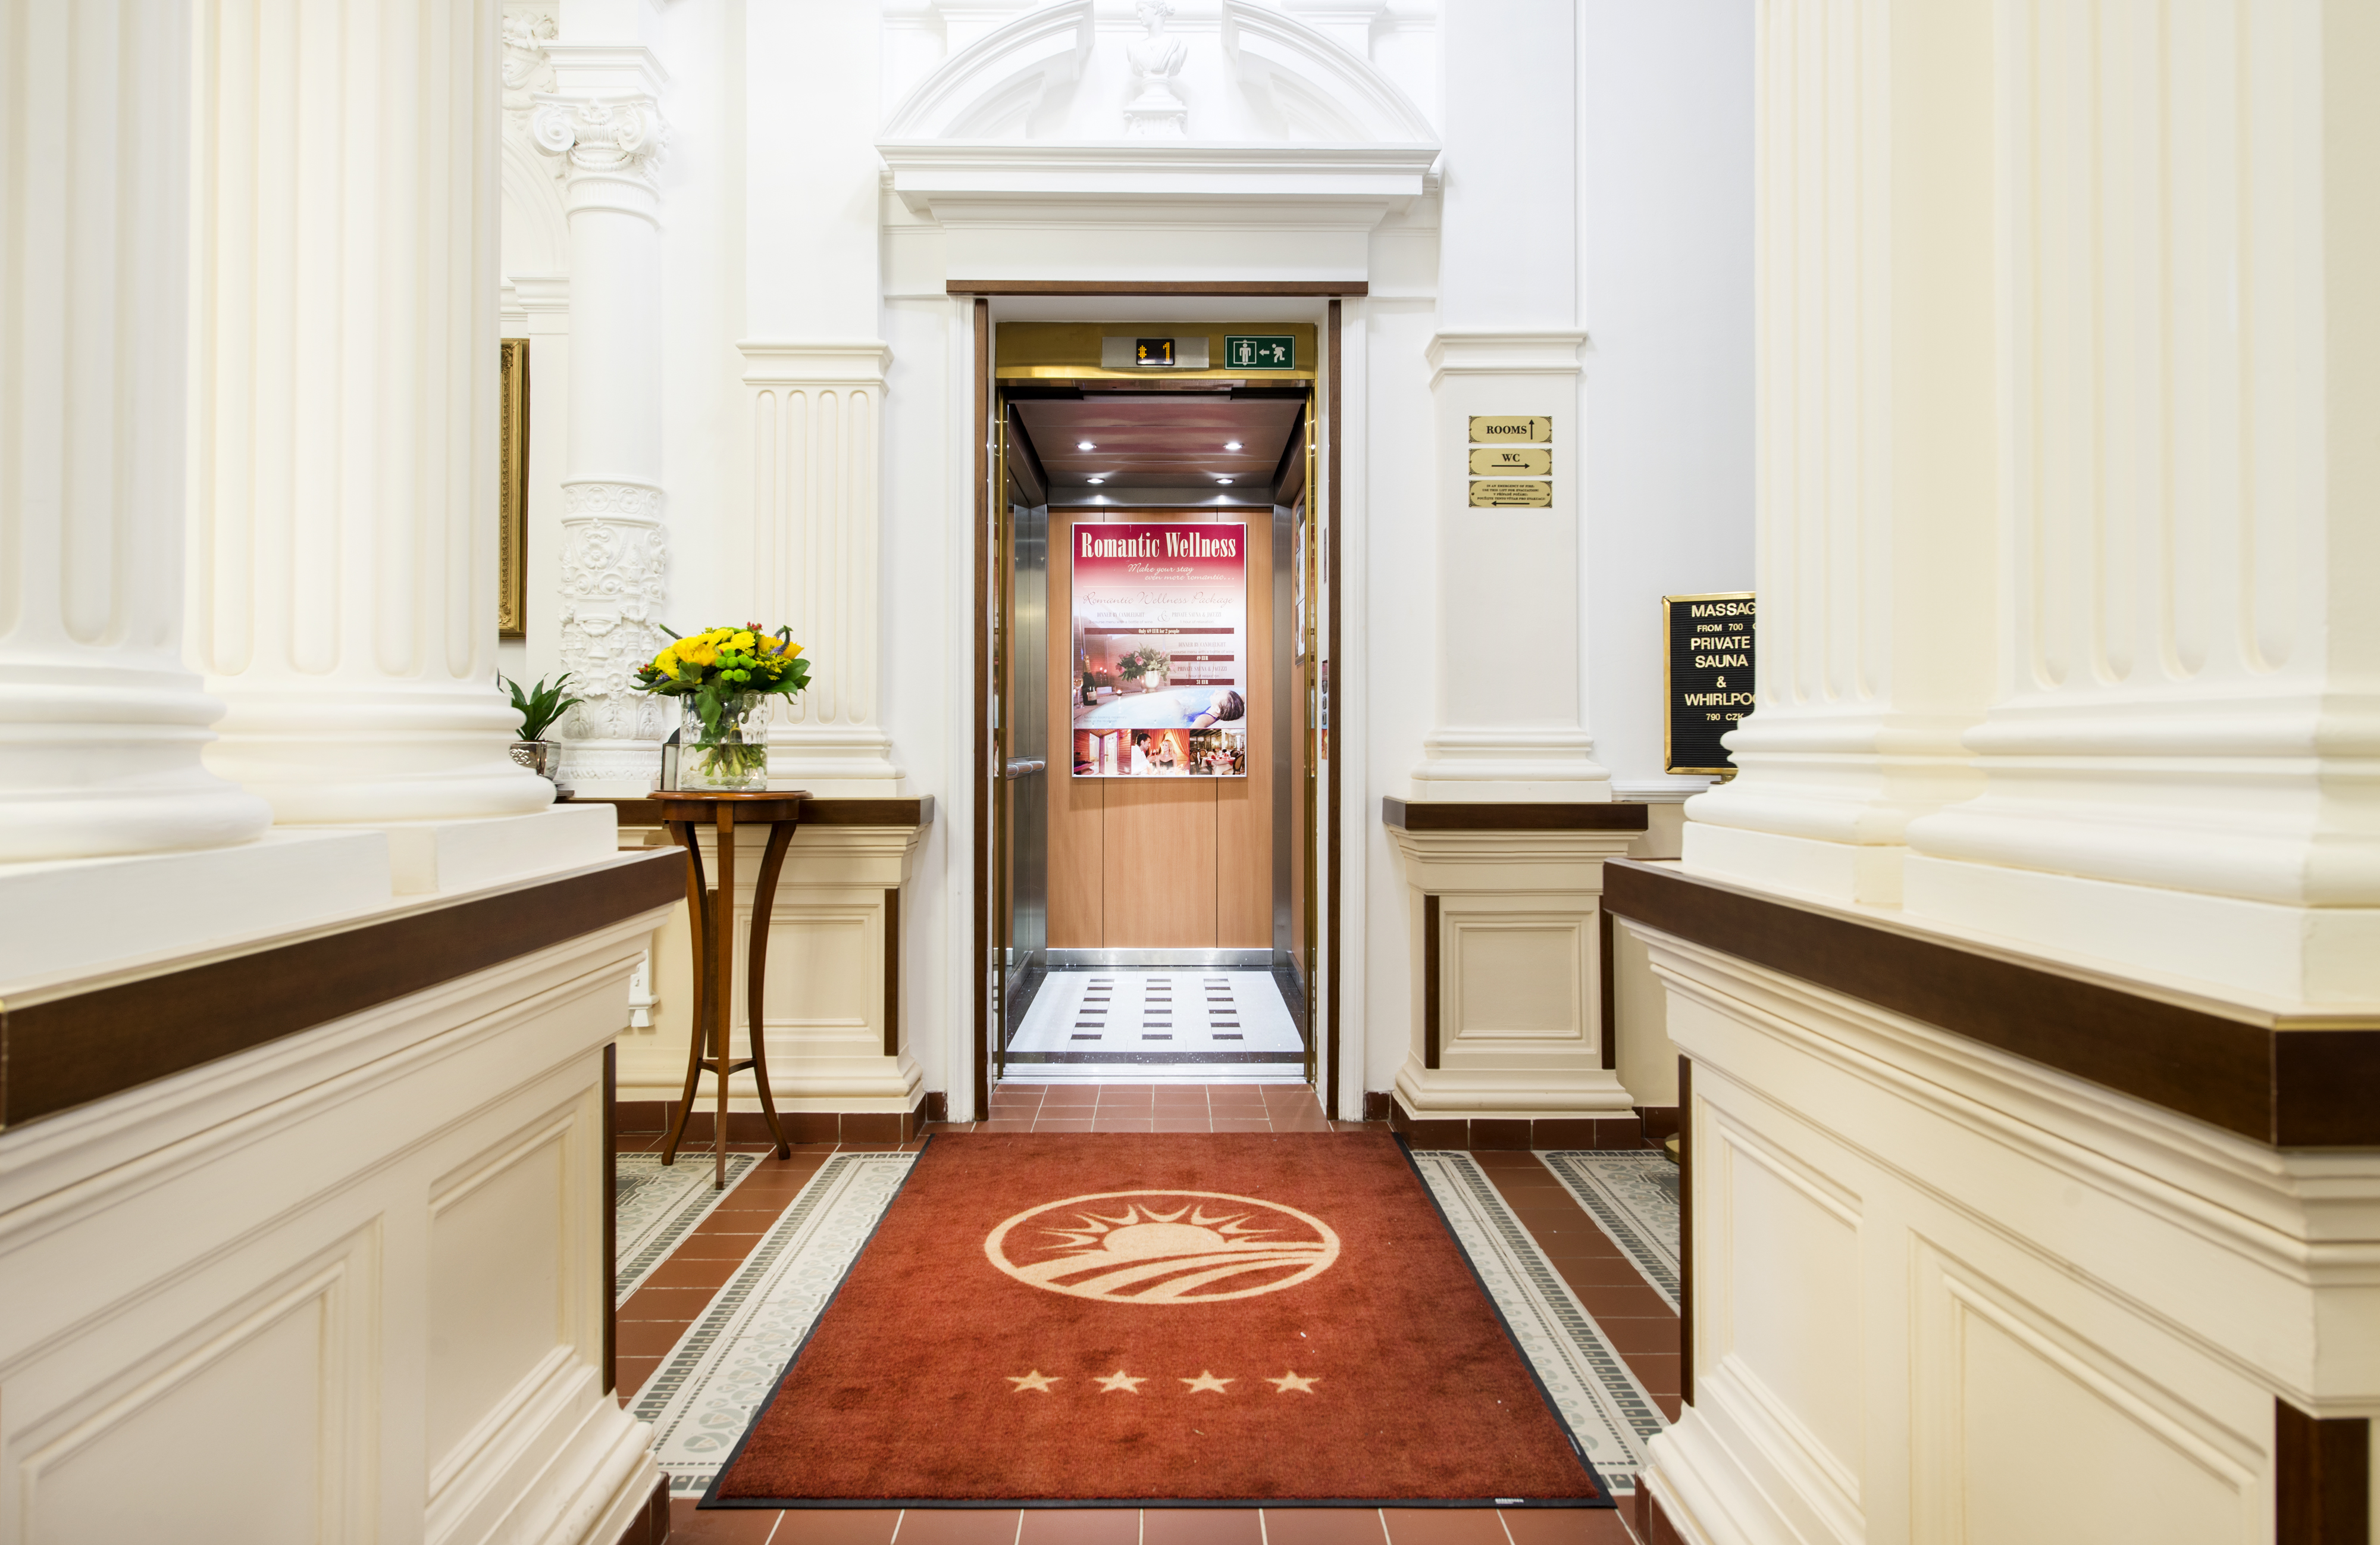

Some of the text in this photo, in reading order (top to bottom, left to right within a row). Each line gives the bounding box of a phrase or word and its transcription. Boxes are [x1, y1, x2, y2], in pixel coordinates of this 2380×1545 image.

[1163, 342, 1170, 362] 1
[1486, 426, 1527, 434] ROOMS
[1502, 454, 1520, 462] WC
[1081, 532, 1236, 558] Romantic Wellness
[1128, 562, 1194, 576] Make your stay
[1083, 592, 1234, 608] Romantic Wellness Package
[1157, 611, 1170, 622] &
[1690, 636, 1750, 650] PRIVATE
[1695, 654, 1749, 668] SAUNA
[1716, 675, 1727, 688] &
[1684, 692, 1756, 706] WHIRLPO
